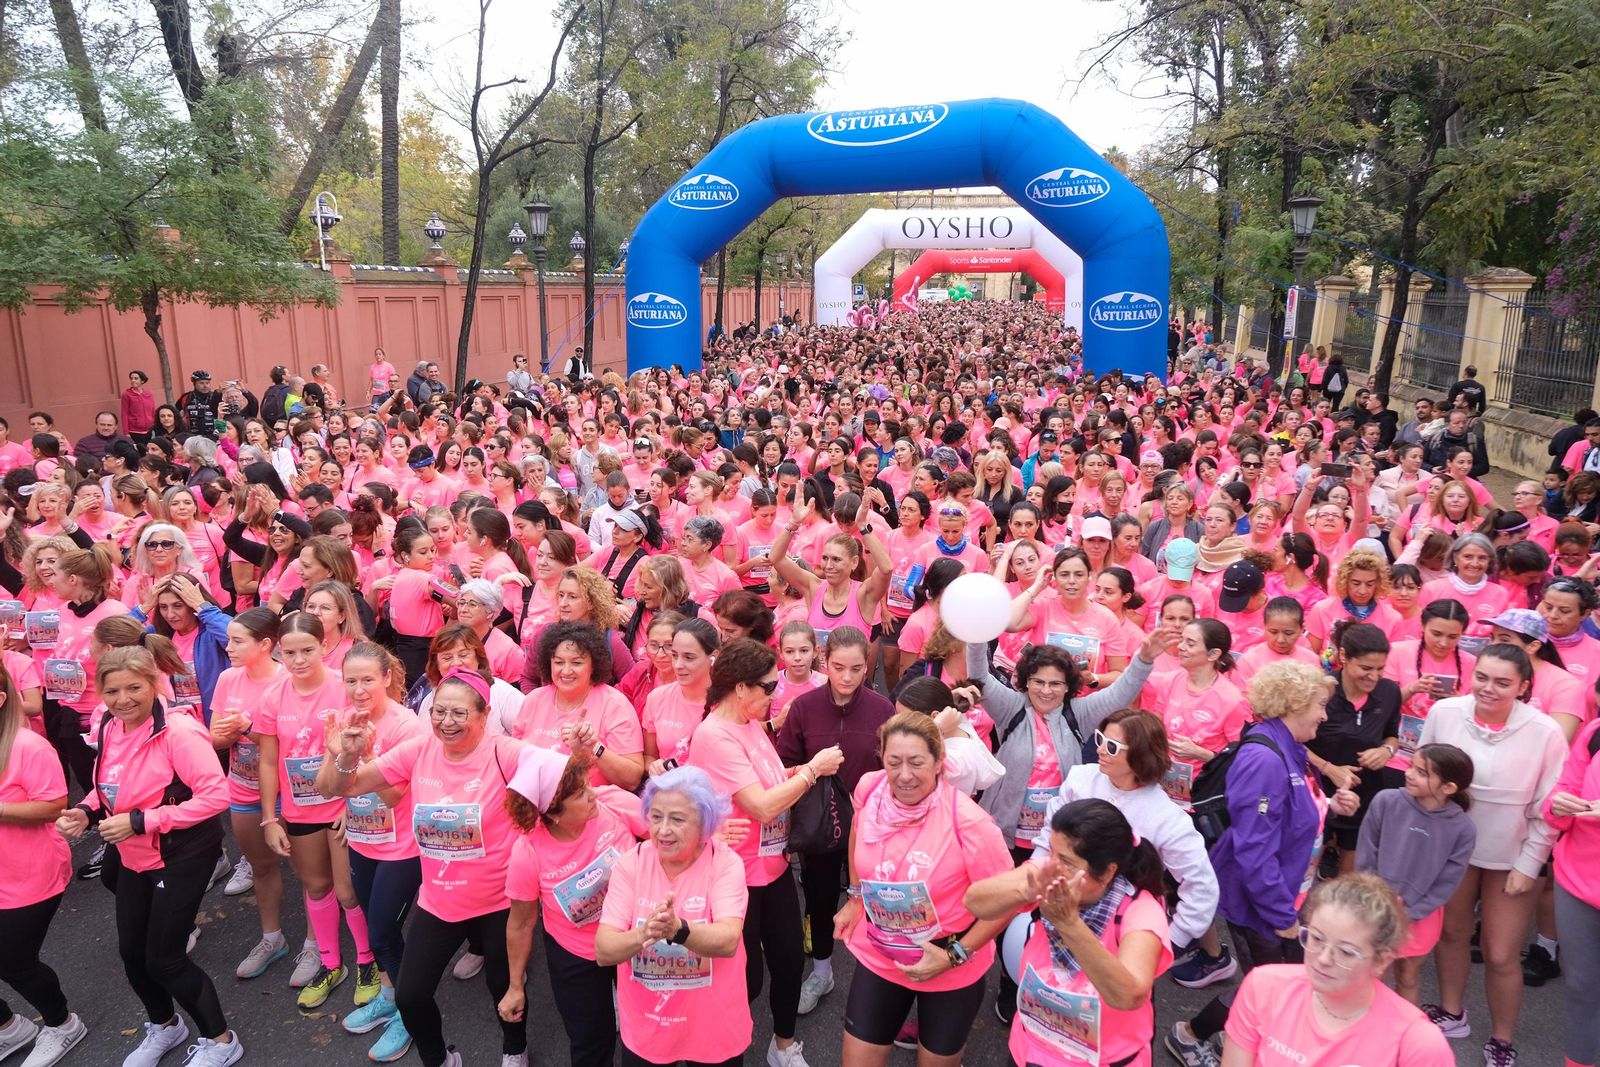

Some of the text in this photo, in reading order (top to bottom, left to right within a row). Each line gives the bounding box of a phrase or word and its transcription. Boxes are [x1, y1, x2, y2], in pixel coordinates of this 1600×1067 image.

[816, 109, 937, 133] ASTURIANA
[672, 189, 733, 201] ASTURIANA
[1032, 183, 1104, 199] ASTURIANA
[902, 216, 1013, 239] OYSHO
[949, 256, 1012, 266] Sports Santander
[628, 305, 682, 319] ASTURIANA
[820, 301, 847, 309] OYSHO
[1094, 306, 1158, 321] ASTURIANA
[546, 861, 577, 880] OYSHO
[657, 956, 687, 967] 016
